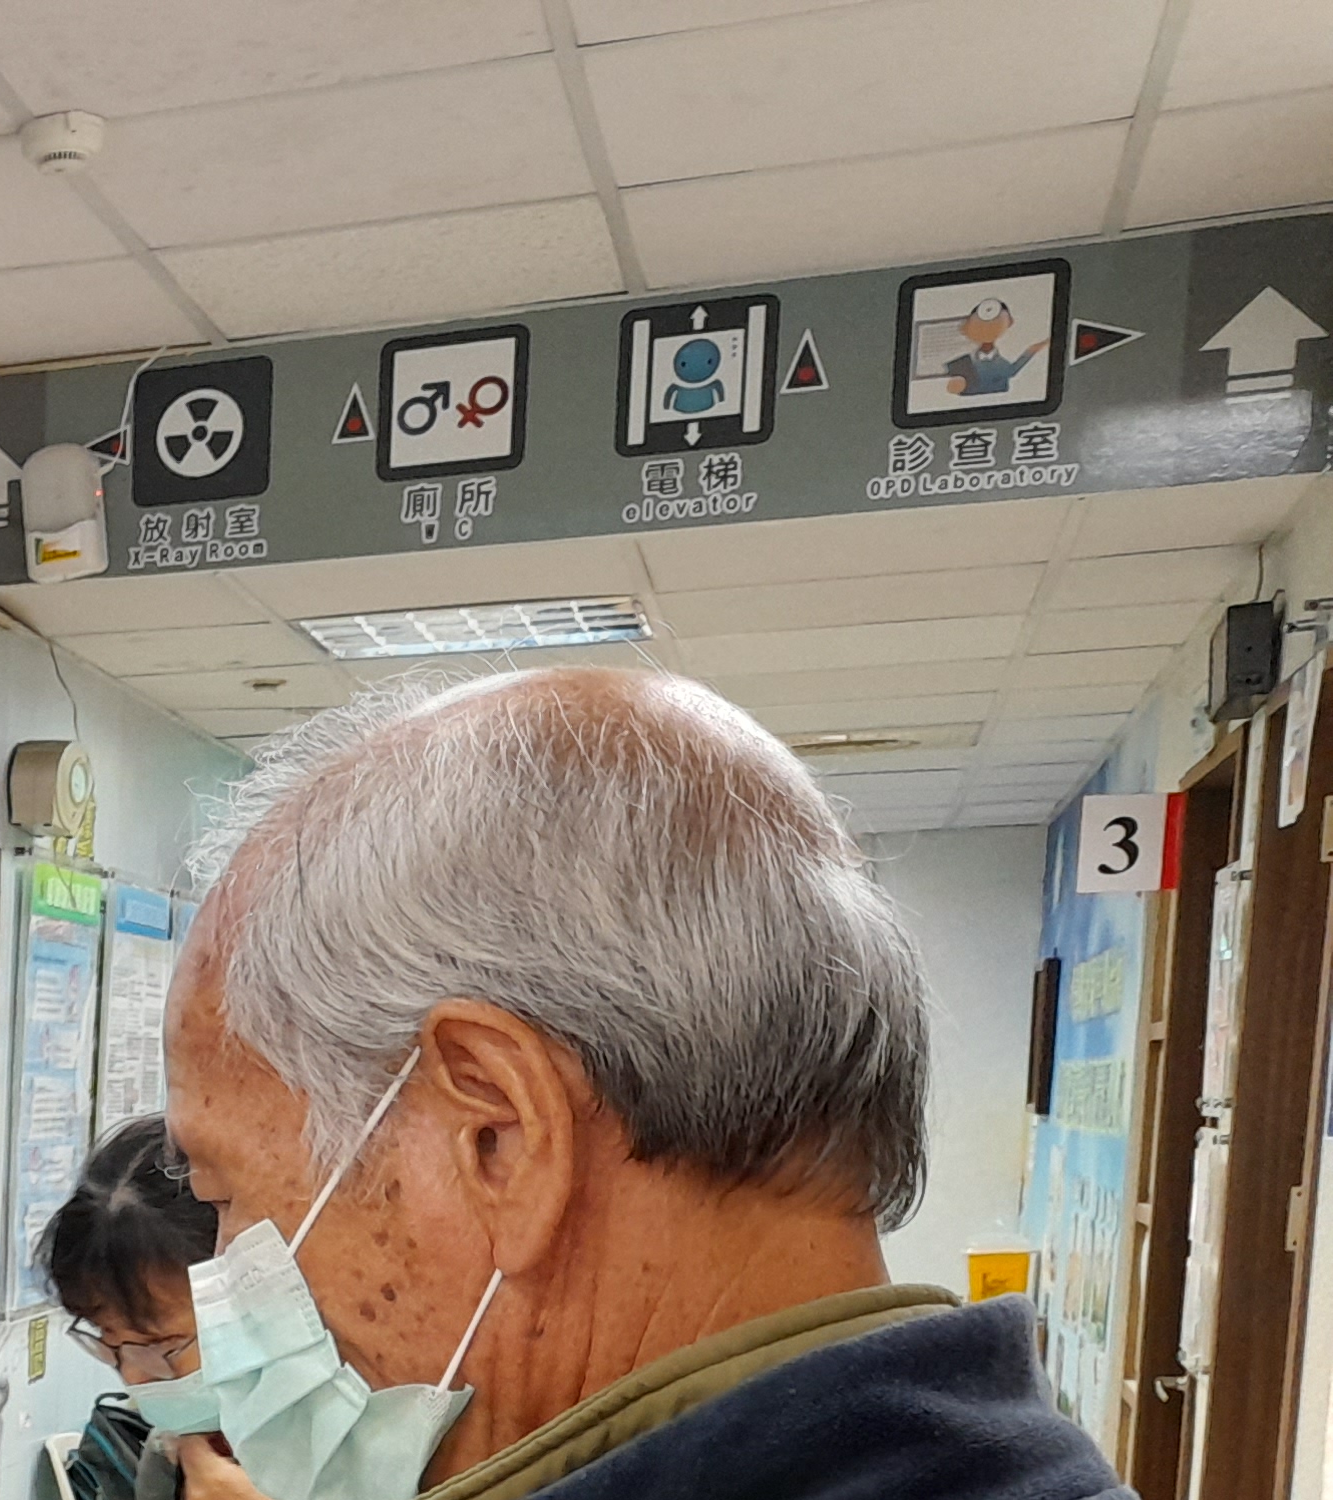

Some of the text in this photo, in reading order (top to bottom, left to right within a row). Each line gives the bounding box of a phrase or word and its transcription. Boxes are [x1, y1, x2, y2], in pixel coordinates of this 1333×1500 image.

[891, 424, 1057, 474] 診查室
[644, 456, 738, 496] 電梯
[868, 465, 1078, 498] OPD Laboratory
[403, 478, 494, 520] 廁所
[625, 495, 756, 522] elevator
[141, 507, 257, 544] 放射室
[130, 541, 265, 567] X-Ray Room
[1096, 816, 1140, 876] 3
